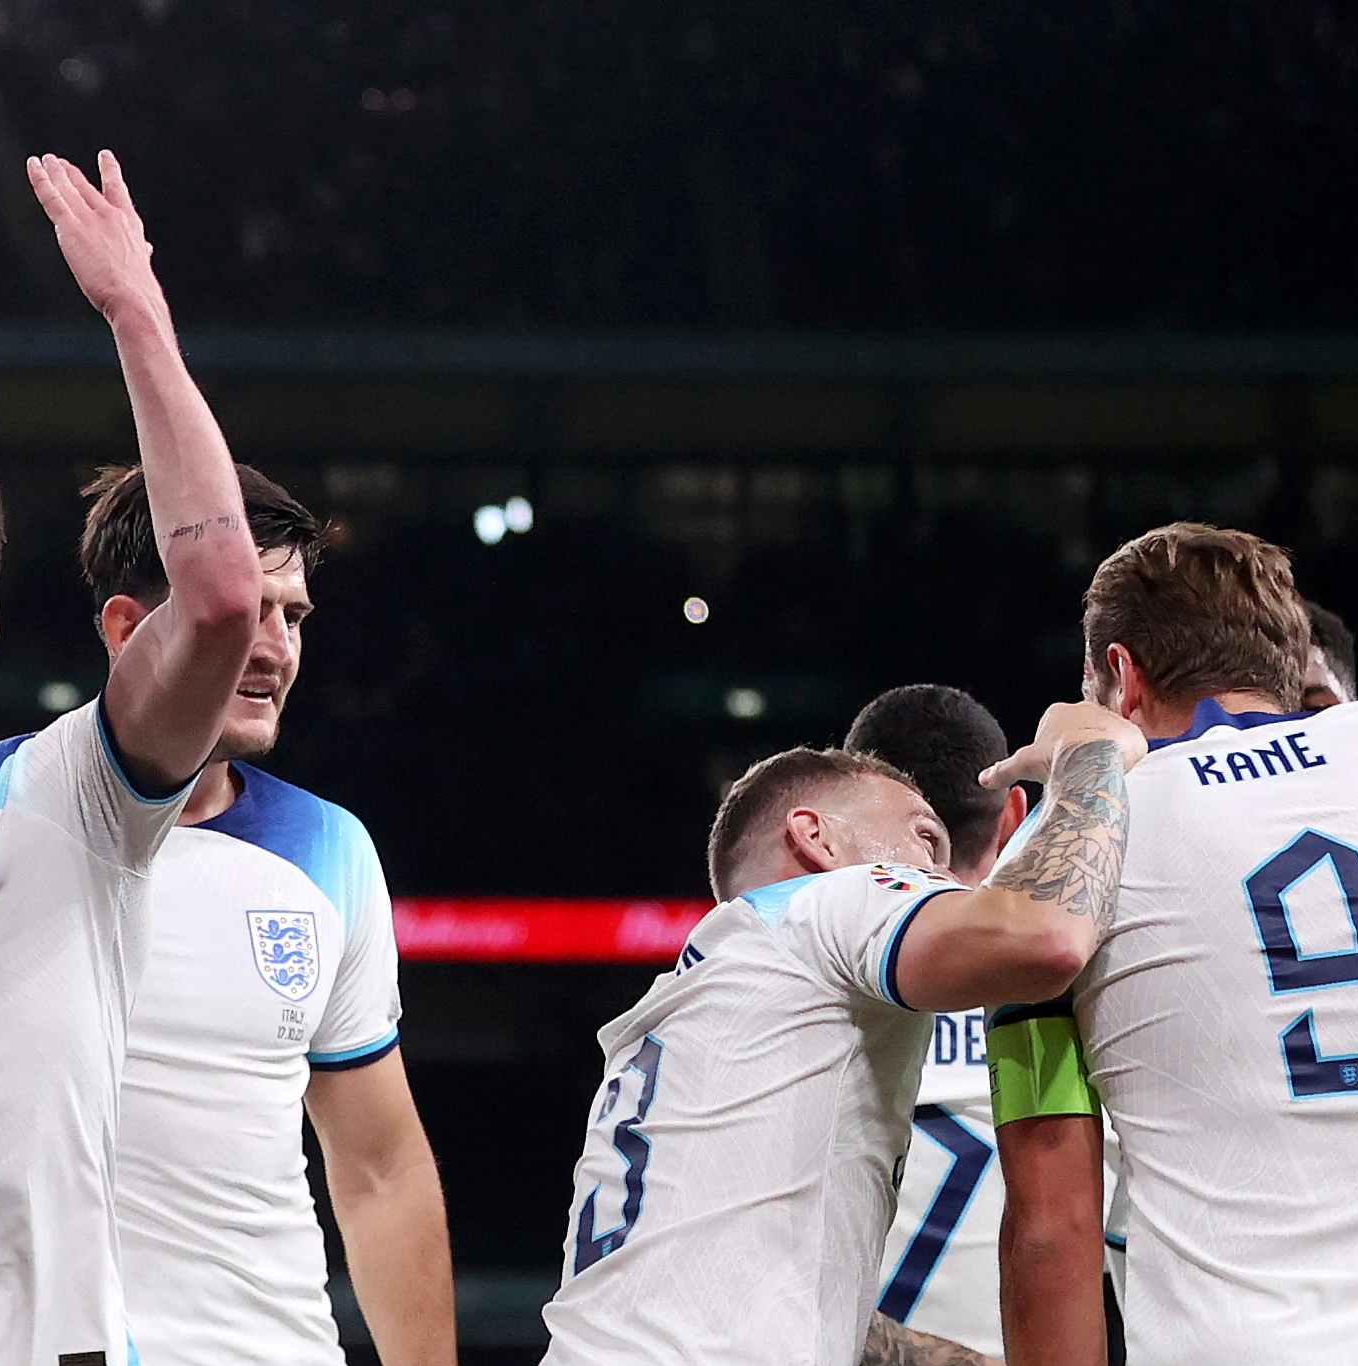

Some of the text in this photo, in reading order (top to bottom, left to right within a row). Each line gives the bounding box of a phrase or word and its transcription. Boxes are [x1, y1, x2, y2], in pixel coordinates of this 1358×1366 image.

[1188, 731, 1328, 786] KANE
[282, 1008, 305, 1025] ITALY
[573, 1031, 665, 1277] 3
[875, 1102, 998, 1326] 7
